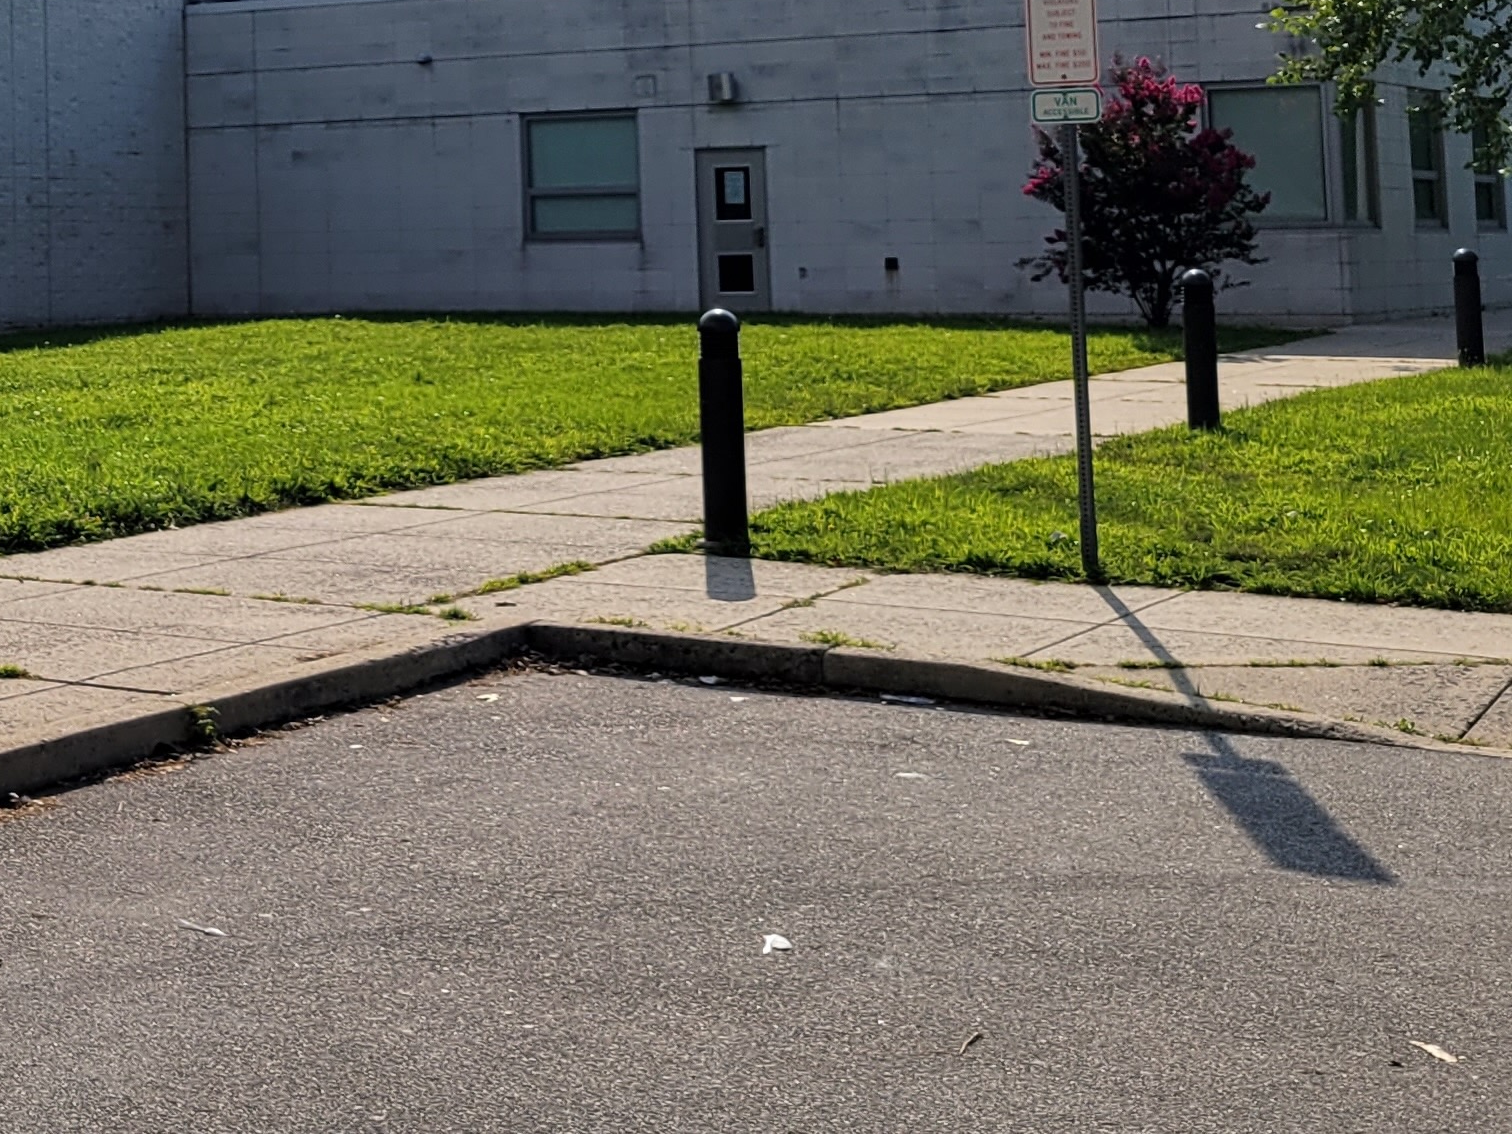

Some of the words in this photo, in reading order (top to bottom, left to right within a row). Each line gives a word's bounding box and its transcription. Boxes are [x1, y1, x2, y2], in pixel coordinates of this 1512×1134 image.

[1047, 8, 1075, 17] SUBJECT
[1059, 20, 1073, 28] FINE
[1058, 31, 1081, 39] TOWING
[1054, 96, 1077, 106] VAN
[1043, 107, 1089, 116] ACCESSIBLE
